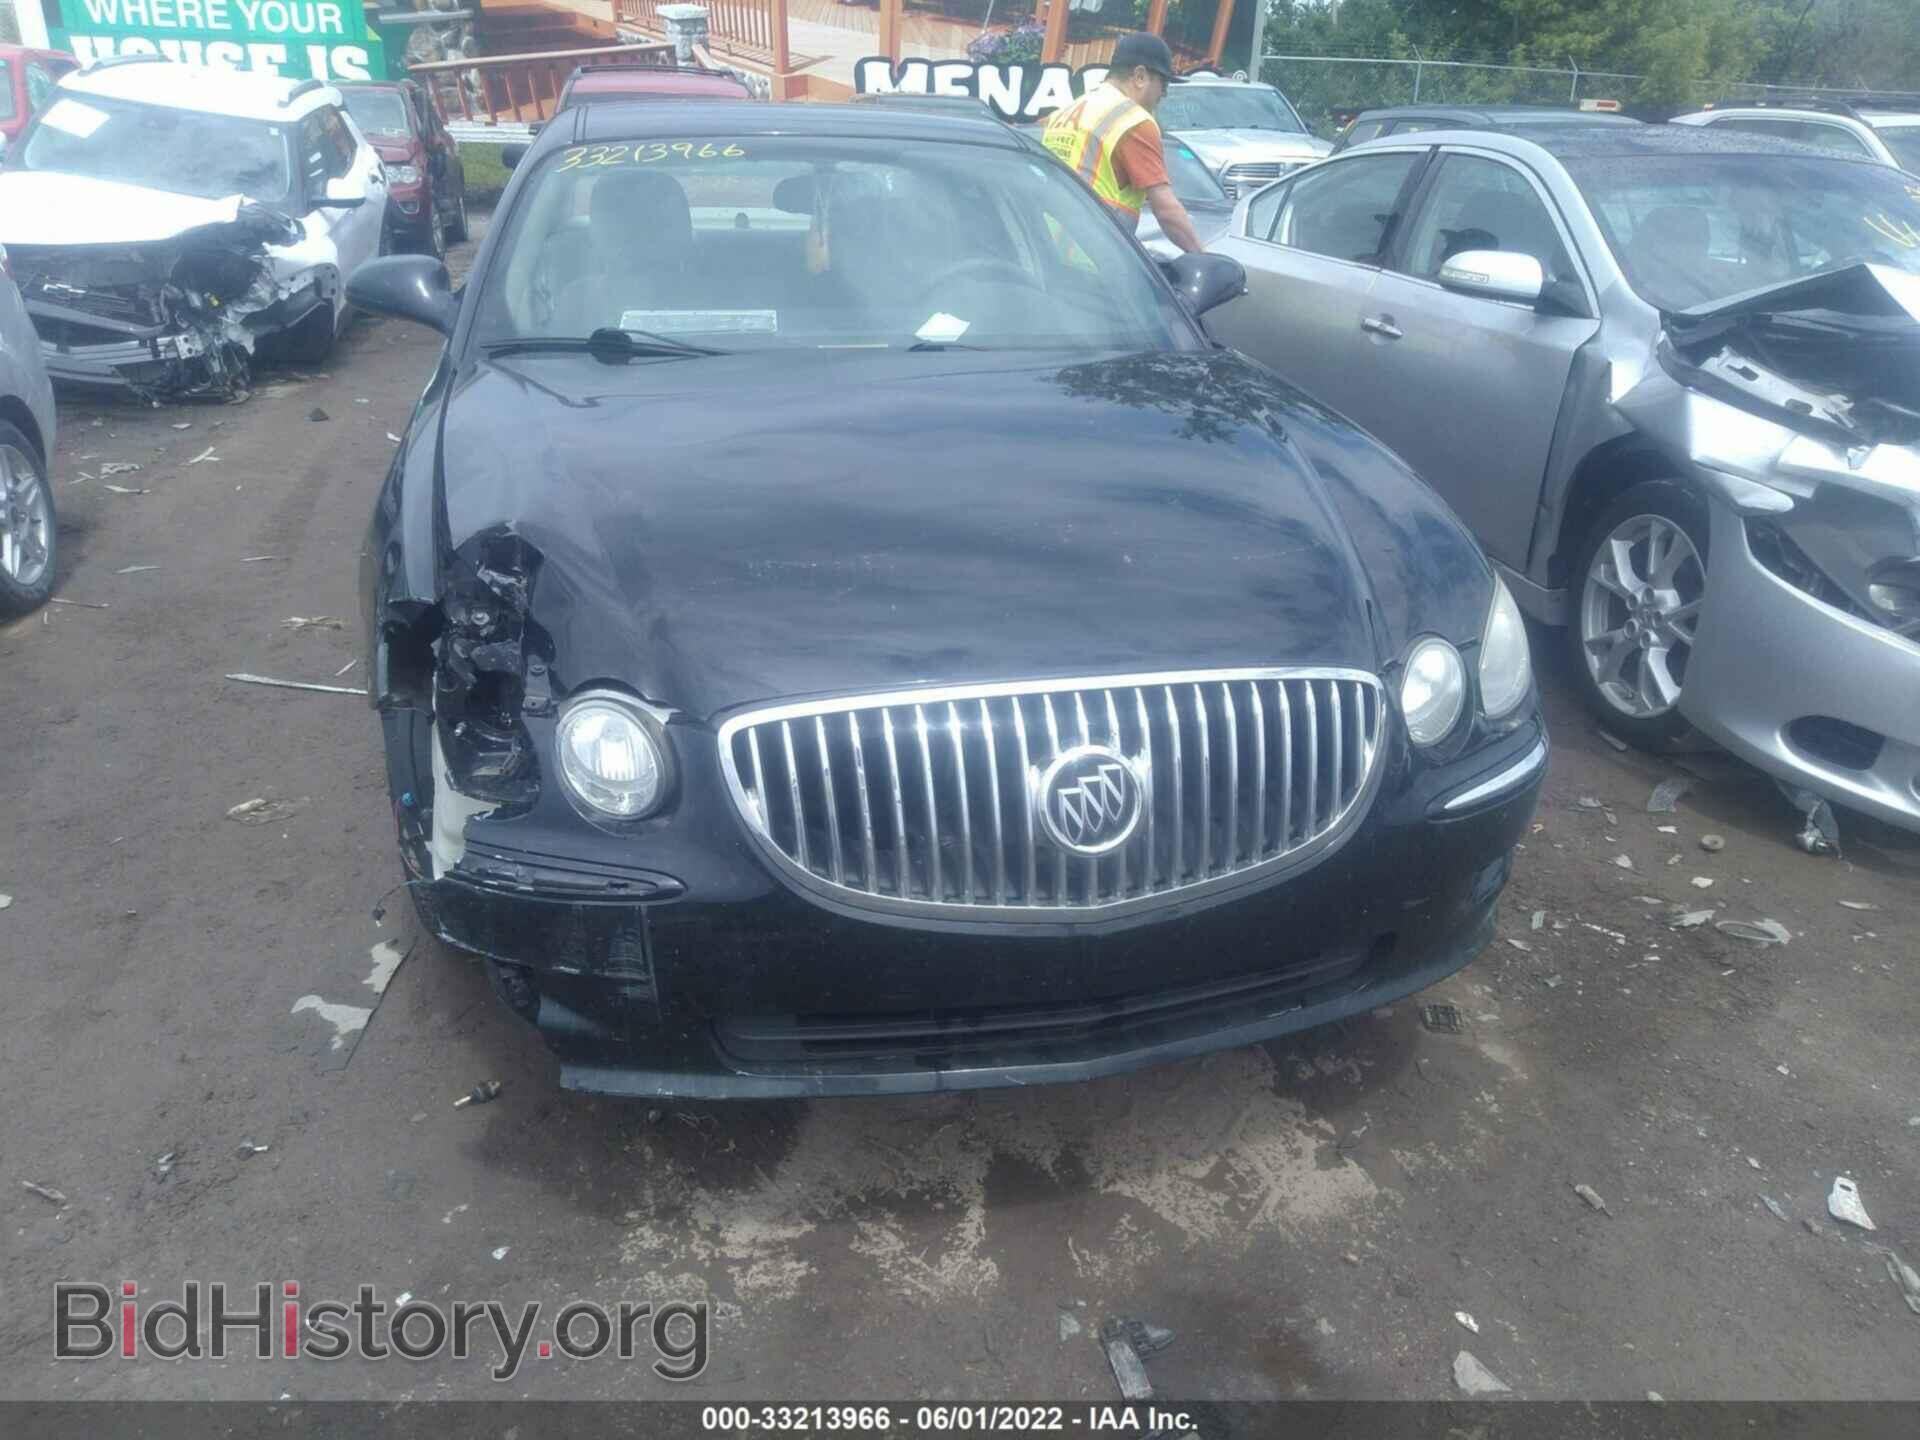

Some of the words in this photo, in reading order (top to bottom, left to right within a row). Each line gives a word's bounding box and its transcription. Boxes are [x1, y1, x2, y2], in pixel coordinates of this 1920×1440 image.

[84, 0, 233, 30] WHERE
[236, 0, 344, 34] YOUR
[306, 44, 373, 82] IS
[553, 143, 745, 174] 33213966
